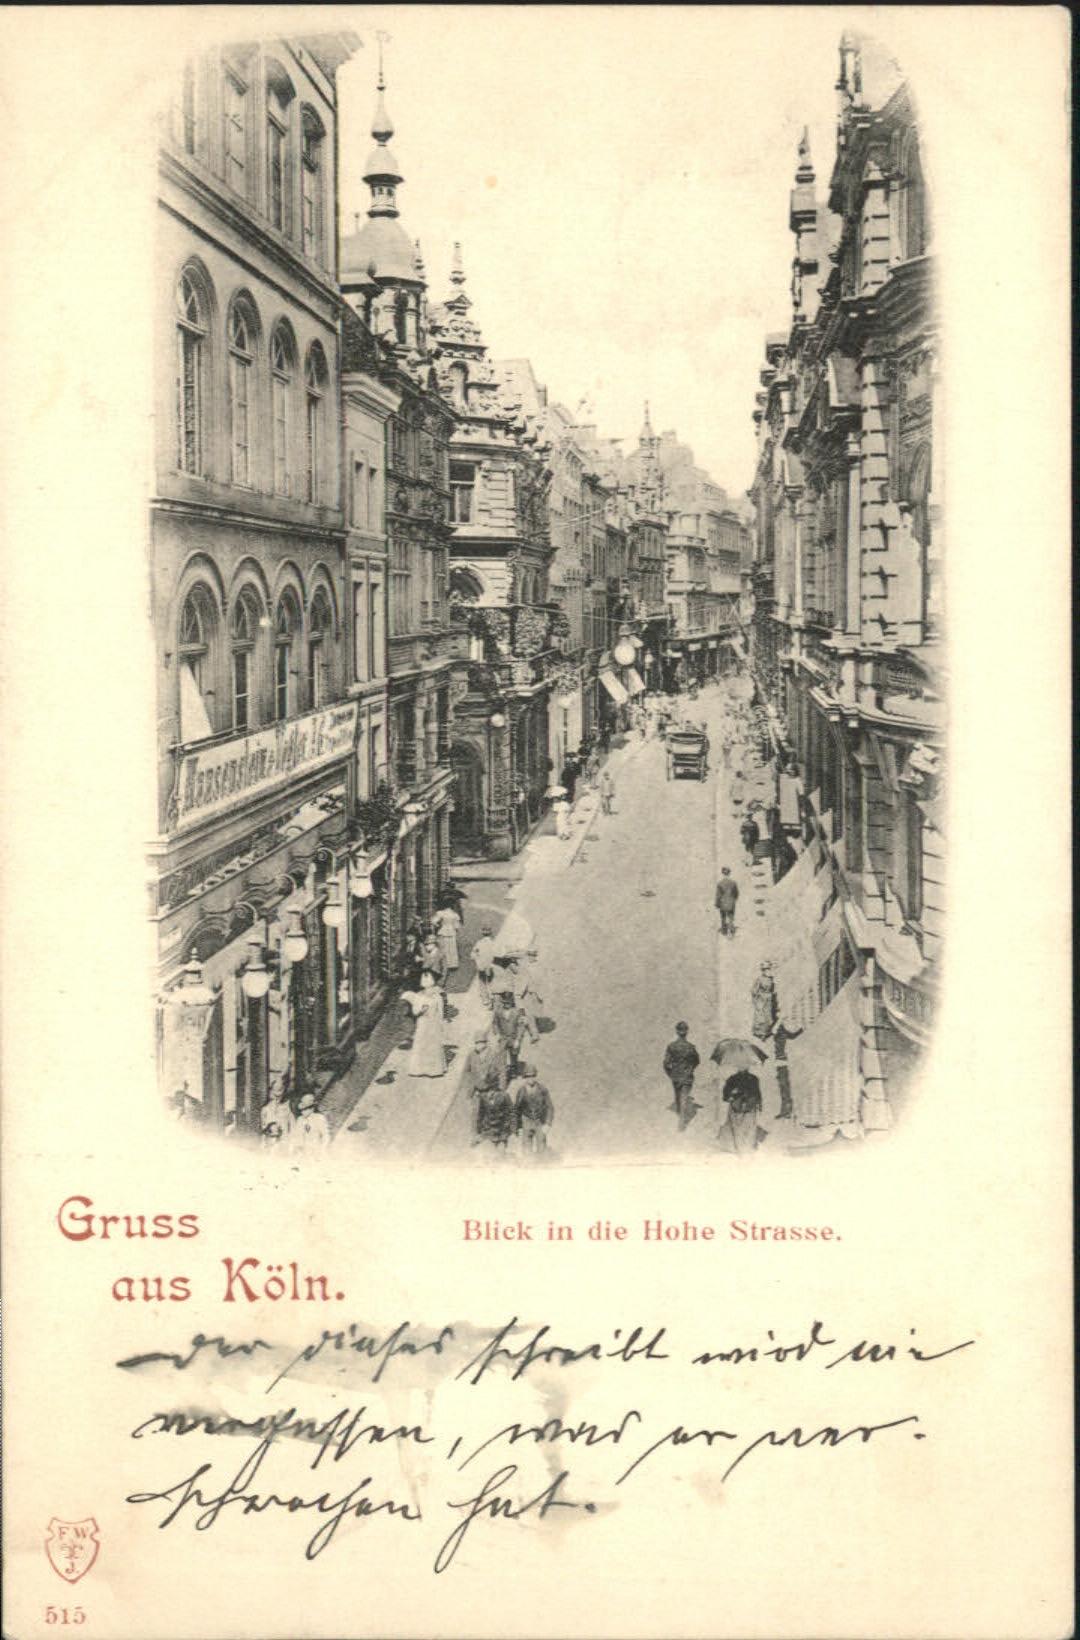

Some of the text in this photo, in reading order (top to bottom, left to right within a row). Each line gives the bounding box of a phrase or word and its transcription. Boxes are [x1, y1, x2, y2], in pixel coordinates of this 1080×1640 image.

[56, 1195, 200, 1242] Gruss
[463, 1220, 842, 1241] Blick in die Hohe Strasse.
[112, 1257, 345, 1303] aus Köln.
[45, 1606, 86, 1624] 515
